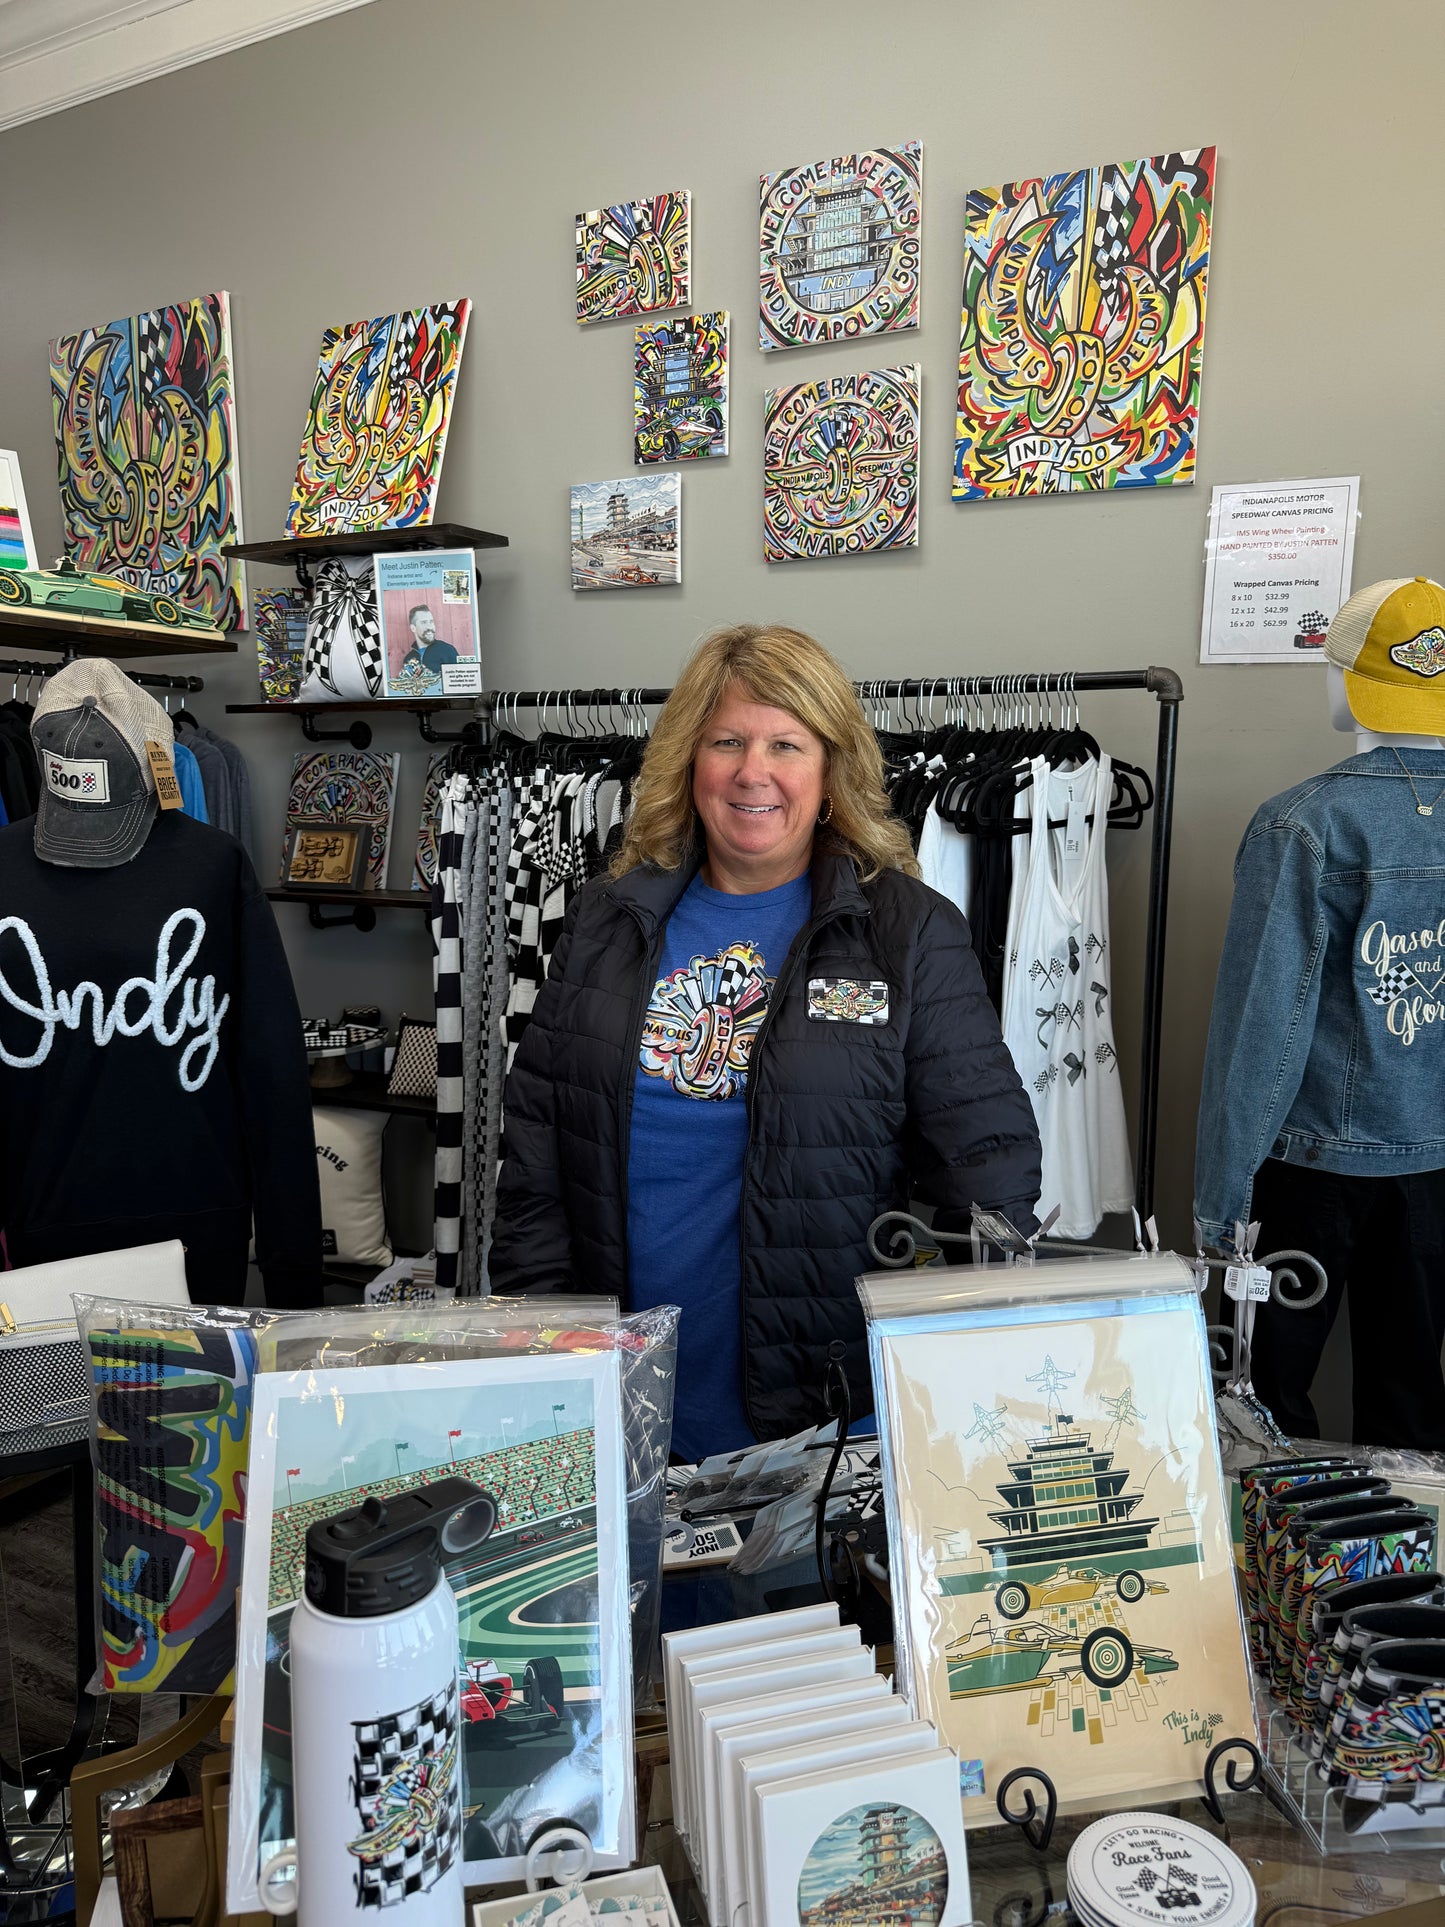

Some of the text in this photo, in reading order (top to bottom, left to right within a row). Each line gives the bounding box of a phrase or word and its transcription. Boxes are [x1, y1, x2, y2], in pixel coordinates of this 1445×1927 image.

[760, 155, 918, 251] WELCOME RACE FANS
[645, 236, 671, 299] MOTOR
[576, 271, 641, 314] INDIANAPOLIS
[760, 238, 919, 340] INDIANAPOLIS 500
[822, 273, 853, 290] INDY
[996, 240, 1047, 381] INDIANAPOLIS
[1108, 277, 1158, 384] SPEEDWAY
[1058, 336, 1099, 432] MOTOR
[327, 363, 354, 459] INDIANAPOLIS
[667, 395, 692, 410] INDY
[386, 384, 424, 461] SPEEDWAY
[765, 377, 918, 466] WELCOME RACE FANS
[73, 366, 123, 515] INDIANAPOLIS
[167, 401, 198, 511] SPEEDWAY
[348, 431, 384, 497] MOTOR
[1014, 439, 1108, 468] INDY 500
[783, 461, 894, 486] INDIANAPOLIS SPEEDWAY
[841, 454, 850, 497] MOTOR
[765, 460, 917, 557] INDIANAPOLIS 500
[1242, 494, 1325, 505] INDIANAPOLIS MOTOR
[131, 470, 160, 566] MOTOR
[323, 502, 379, 523] INDY 500
[1231, 507, 1334, 520] SPEEDWAY CANVAS PRICING
[1236, 526, 1325, 538] IMS Wing Wheel Painting
[1219, 543, 1241, 551] HAND
[1242, 541, 1273, 550] PAINTED
[1283, 540, 1310, 548] JUSTIN
[1310, 538, 1339, 547] PATTEN
[399, 562, 419, 570] Justin
[1267, 552, 1297, 561] $350.00
[151, 573, 179, 594] 500
[1233, 579, 1320, 589] Wrapped Canvas Pricing
[1265, 593, 1290, 601] $32.99
[1230, 607, 1239, 615] 12
[1263, 606, 1289, 615] $42.99
[1245, 620, 1255, 628] 20
[1263, 619, 1288, 628] $62.99
[51, 770, 80, 790] 500
[157, 776, 178, 792] BRIEF
[288, 754, 389, 815] WELCOME RACE FANS
[1414, 955, 1443, 973] and
[0, 907, 230, 1092] Indy
[704, 1015, 730, 1076] MOTOR
[156, 1342, 165, 1379] WARNING:
[688, 1543, 720, 1559] INDY
[689, 1531, 716, 1549] 50
[1162, 1708, 1200, 1730] This is
[1181, 1719, 1214, 1749] Indy
[1106, 1828, 1178, 1848] LET'S GO RACING
[1128, 1839, 1160, 1849] WELCOME
[1111, 1846, 1192, 1867] Race Fans
[1115, 1885, 1136, 1893] Good
[1200, 1875, 1221, 1883] Good
[1136, 1896, 1227, 1924] START YOUR ENGINES
